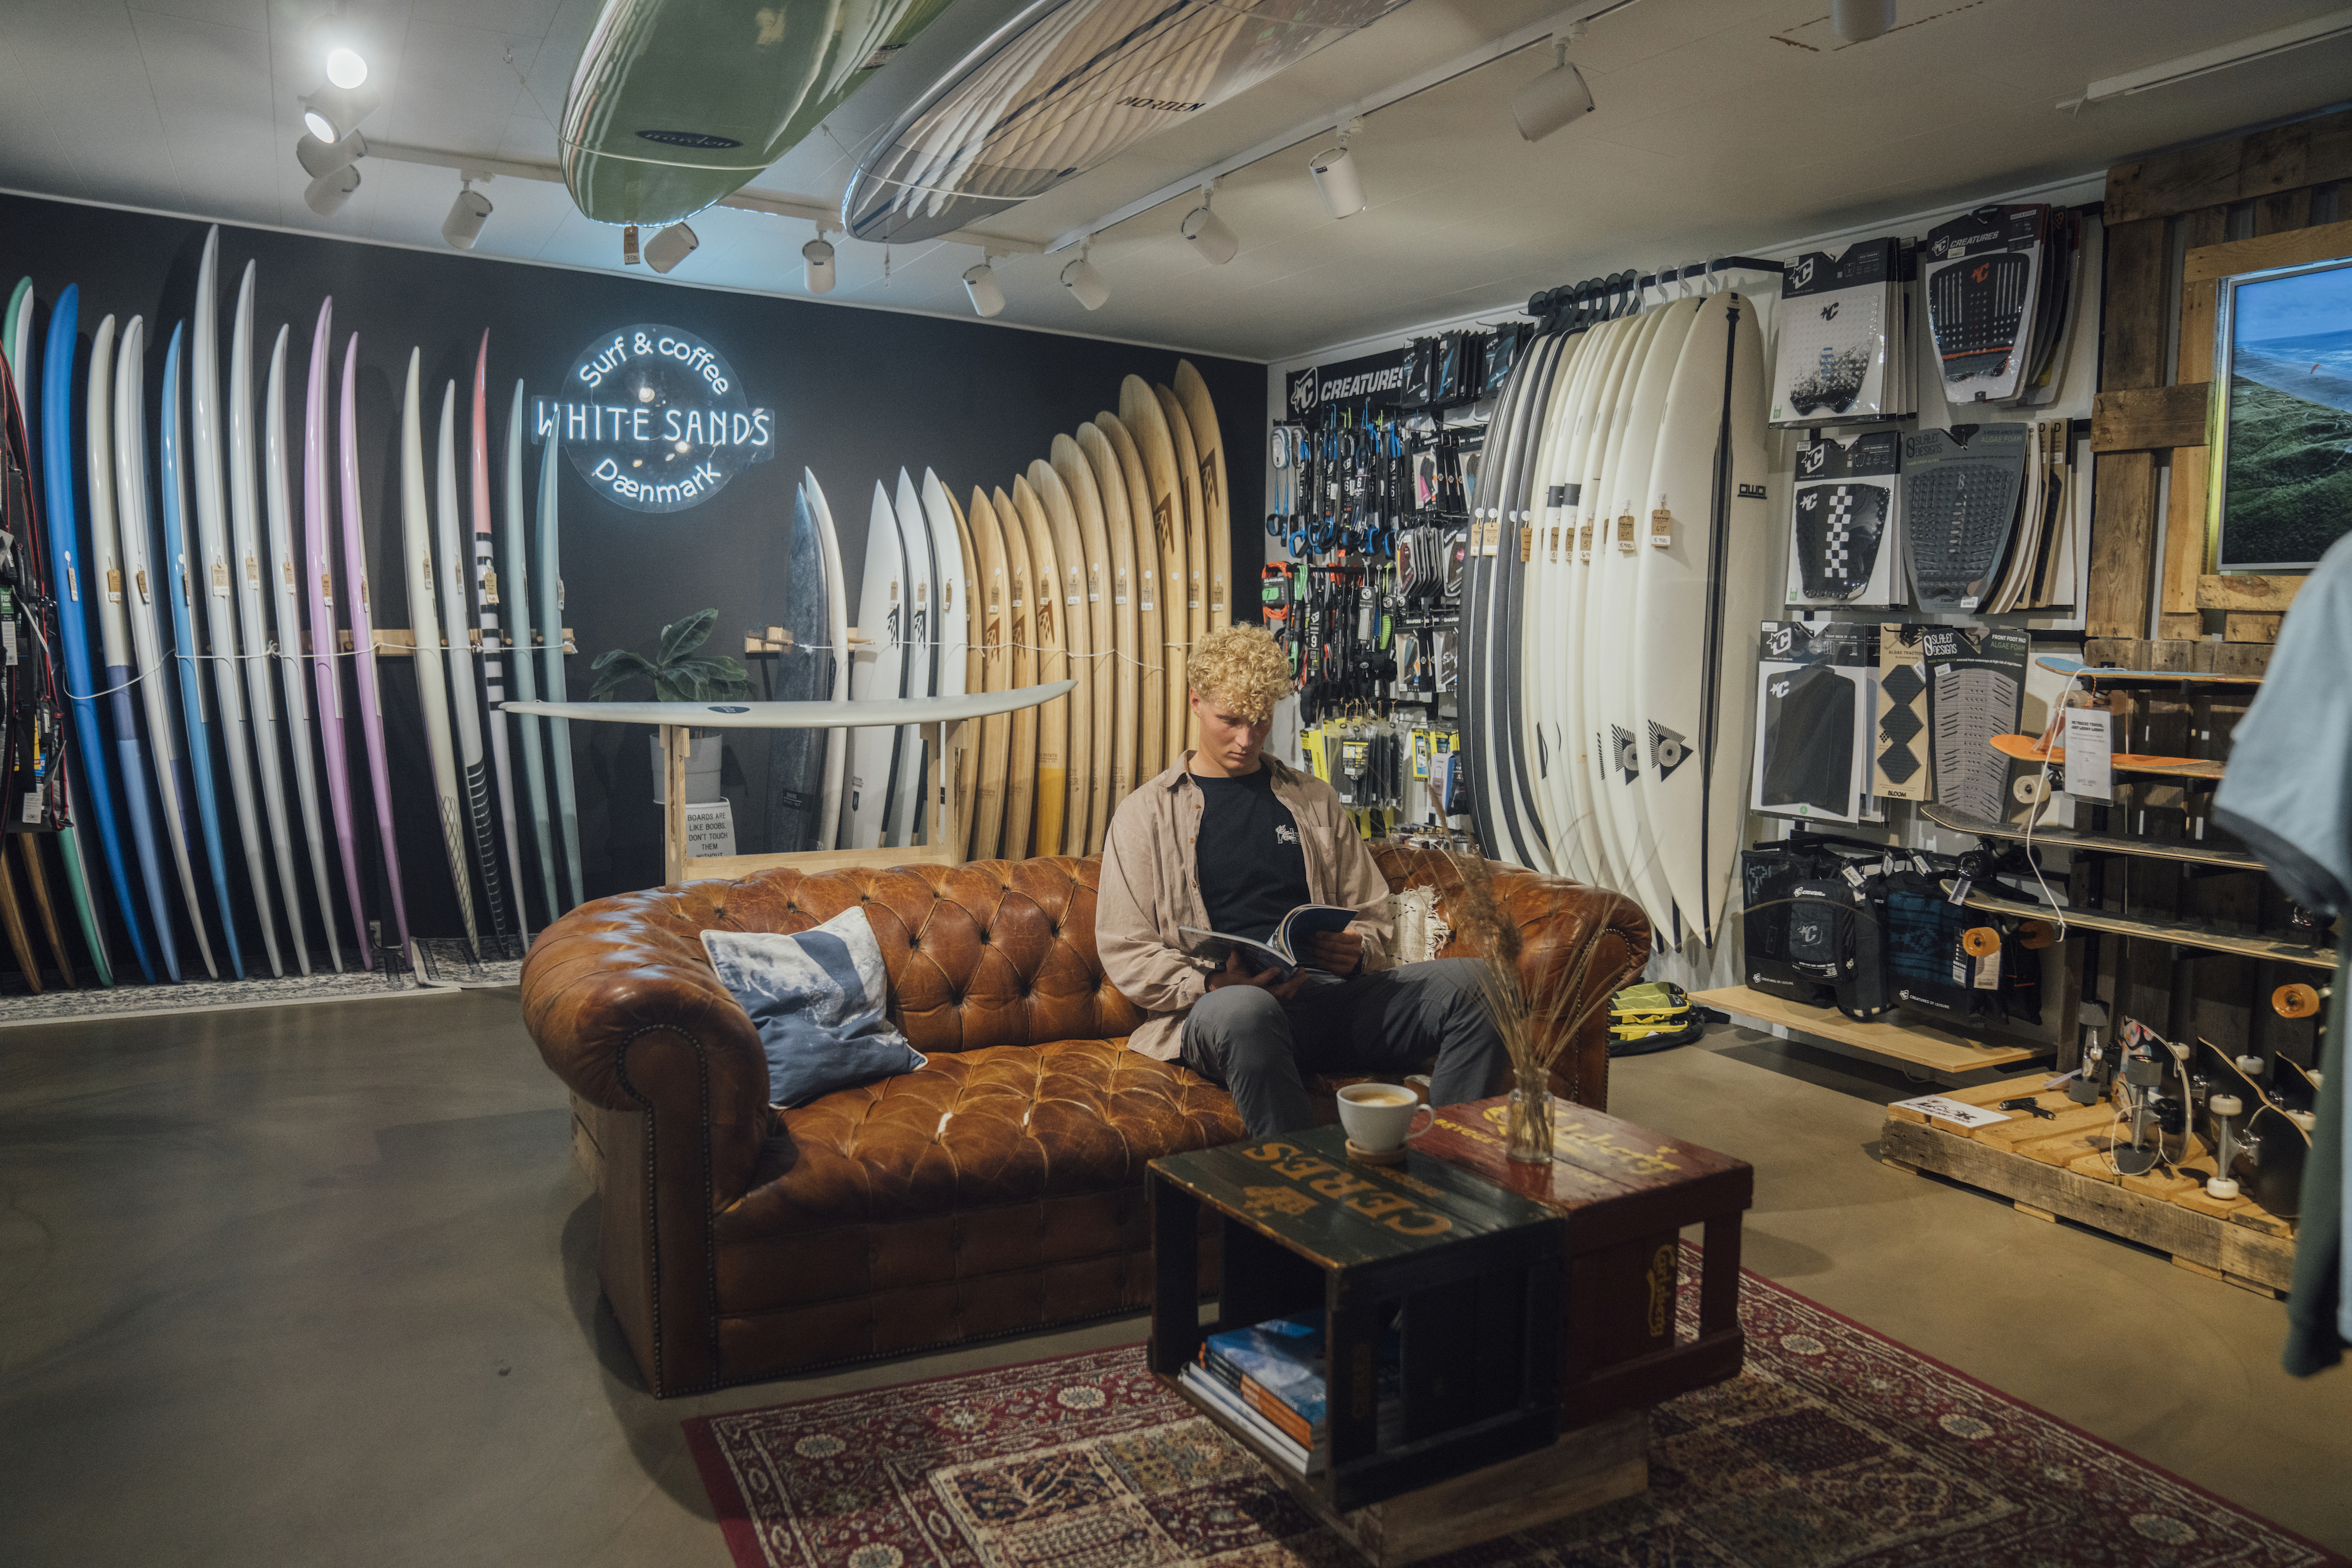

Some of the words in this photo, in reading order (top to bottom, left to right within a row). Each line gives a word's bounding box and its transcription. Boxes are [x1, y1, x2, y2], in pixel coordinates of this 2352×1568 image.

[1116, 96, 1207, 112] NORDEN
[646, 134, 733, 147] norden
[1950, 230, 1999, 249] CREATURES
[579, 336, 627, 388] Surf
[634, 332, 654, 355] &
[659, 337, 729, 395] coffee
[1321, 367, 1403, 402] CREATURES
[537, 400, 650, 441] WHITE
[663, 409, 770, 446] SANDS
[594, 457, 721, 503] Dænmark
[1357, 477, 1362, 487] 6
[1299, 486, 1304, 497] 6
[1327, 485, 1330, 496] 6
[1344, 481, 1349, 492] 6
[1391, 486, 1395, 497] 6
[1265, 590, 1271, 599] 7
[1311, 636, 1317, 647] 9
[1990, 641, 2010, 649] ALGAE
[2010, 643, 2026, 651] FOAM
[706, 822, 727, 830] BOOBS,
[689, 833, 707, 841] DON'T
[709, 832, 728, 840] TOUCH
[701, 842, 718, 851] THEM
[1910, 995, 1930, 1004] CREATURES
[1242, 1142, 1452, 1236] CERES
